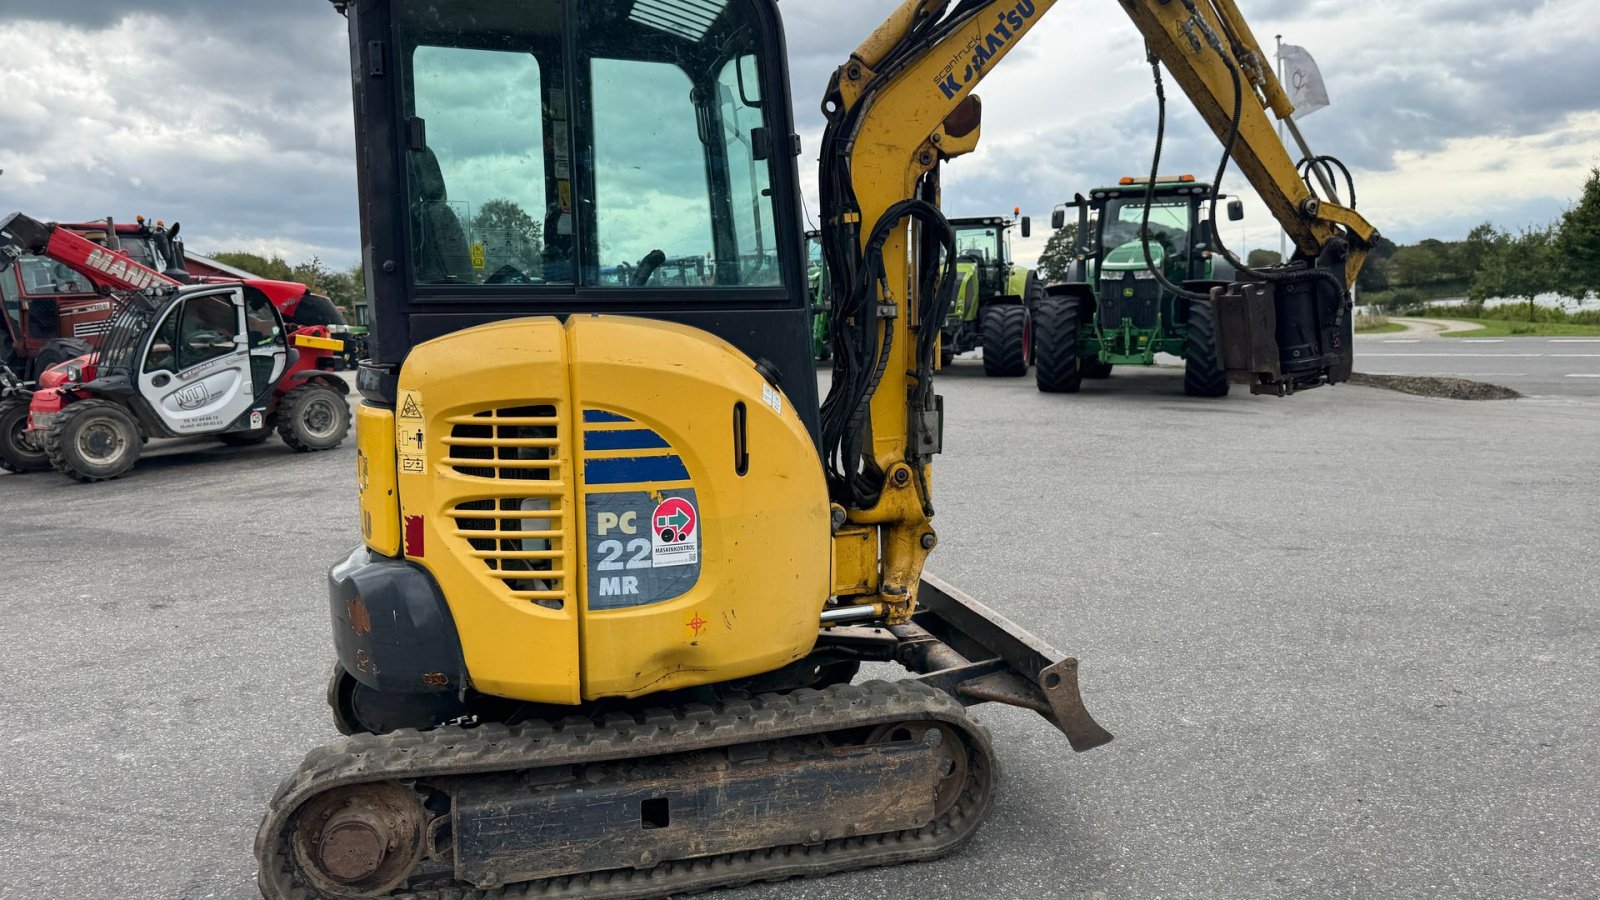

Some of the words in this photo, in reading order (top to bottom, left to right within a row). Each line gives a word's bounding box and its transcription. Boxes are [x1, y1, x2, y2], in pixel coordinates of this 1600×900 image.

[933, 34, 981, 85] scantruck
[85, 248, 173, 290] MANIT
[597, 511, 637, 535] PC
[597, 538, 652, 571] 22
[655, 545, 696, 554] MASKINKONTROL
[599, 575, 639, 596] MR
